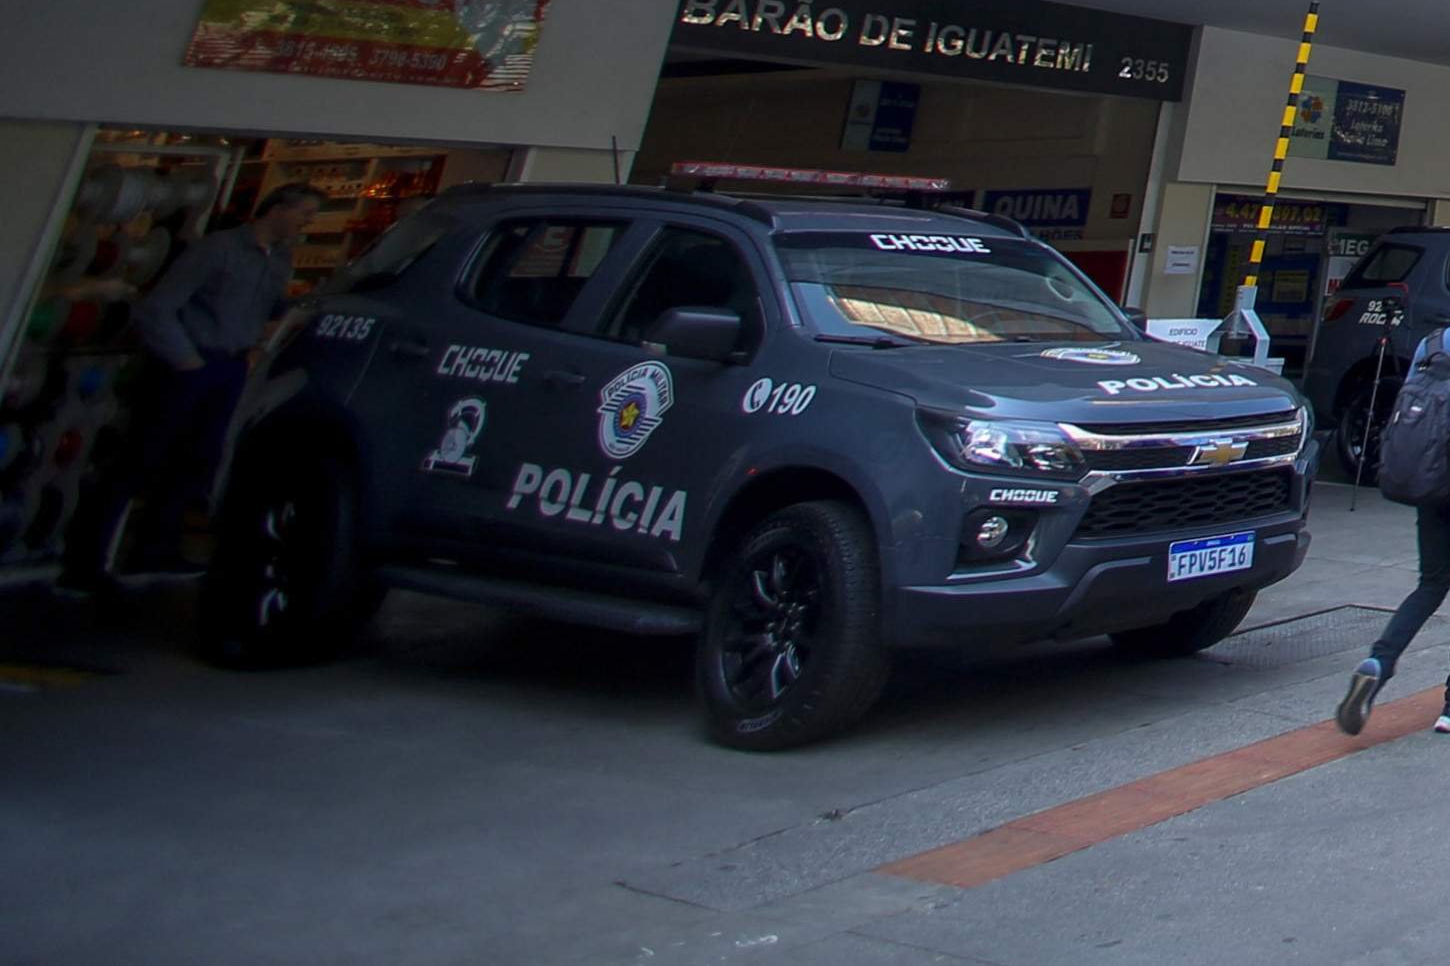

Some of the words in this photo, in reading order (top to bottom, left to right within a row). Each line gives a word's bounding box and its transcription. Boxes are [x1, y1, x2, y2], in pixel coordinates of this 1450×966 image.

[856, 12, 914, 52] DE
[924, 21, 1094, 74] IGUATEMI
[1115, 55, 1171, 83] 2355
[993, 194, 1080, 220] QUINA
[868, 234, 992, 253] CHOQUE
[315, 314, 376, 340] 92135
[437, 345, 530, 383] CHOQUE
[1097, 373, 1257, 395] POLÍCIA
[767, 382, 817, 415] 190
[506, 462, 688, 541] POLÍCIA
[989, 489, 1059, 502] CHOQUE
[1177, 546, 1246, 576] FPV5F16
